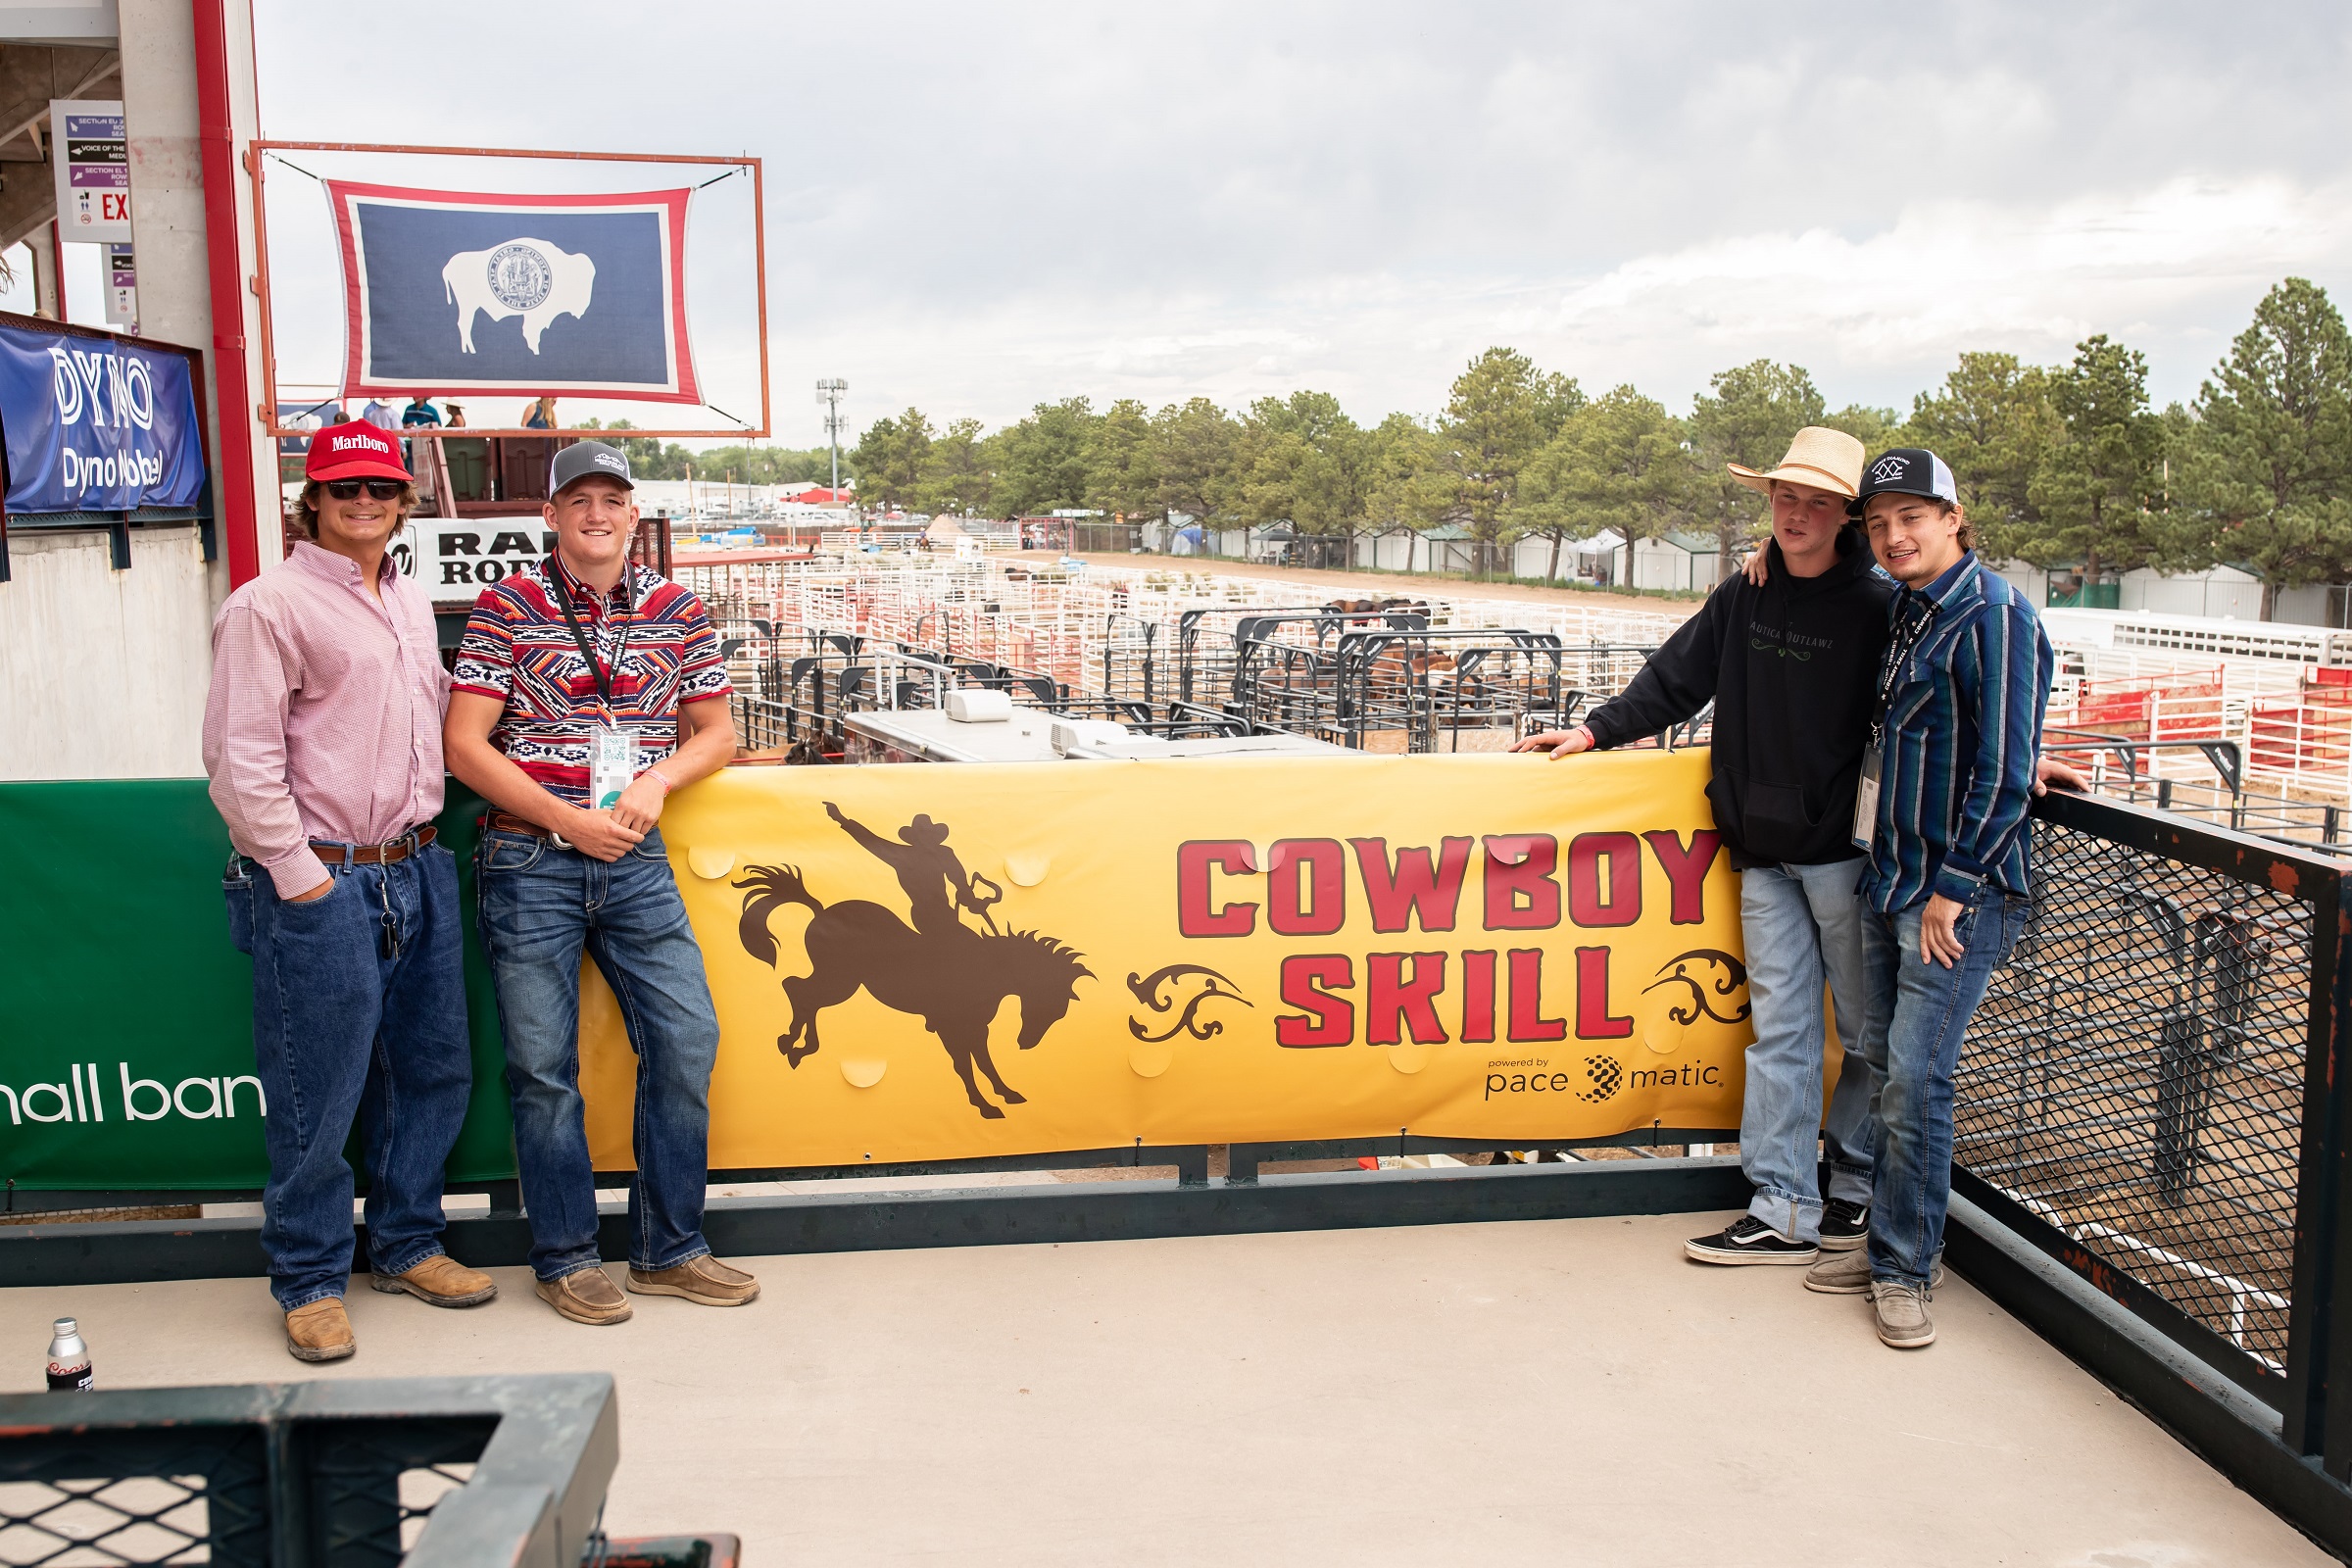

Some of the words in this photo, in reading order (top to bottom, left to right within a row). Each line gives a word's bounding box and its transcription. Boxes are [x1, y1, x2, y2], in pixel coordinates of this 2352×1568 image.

[102, 193, 129, 220] EX
[47, 347, 153, 430] DYNO
[331, 434, 389, 454] Marlboro
[63, 447, 117, 498] Dyno
[118, 449, 163, 487] Nobel
[1914, 609, 1933, 635] COWBOY
[1786, 630, 1834, 649] OUTLAWZ
[1885, 664, 1899, 691] COWBOY
[1896, 648, 1908, 666] SKILL
[1177, 828, 1724, 939] COWBOY
[1274, 945, 1635, 1049] SKILL
[1488, 1058, 1534, 1069] powered
[1536, 1057, 1549, 1068] by
[1485, 1072, 1569, 1102] pace
